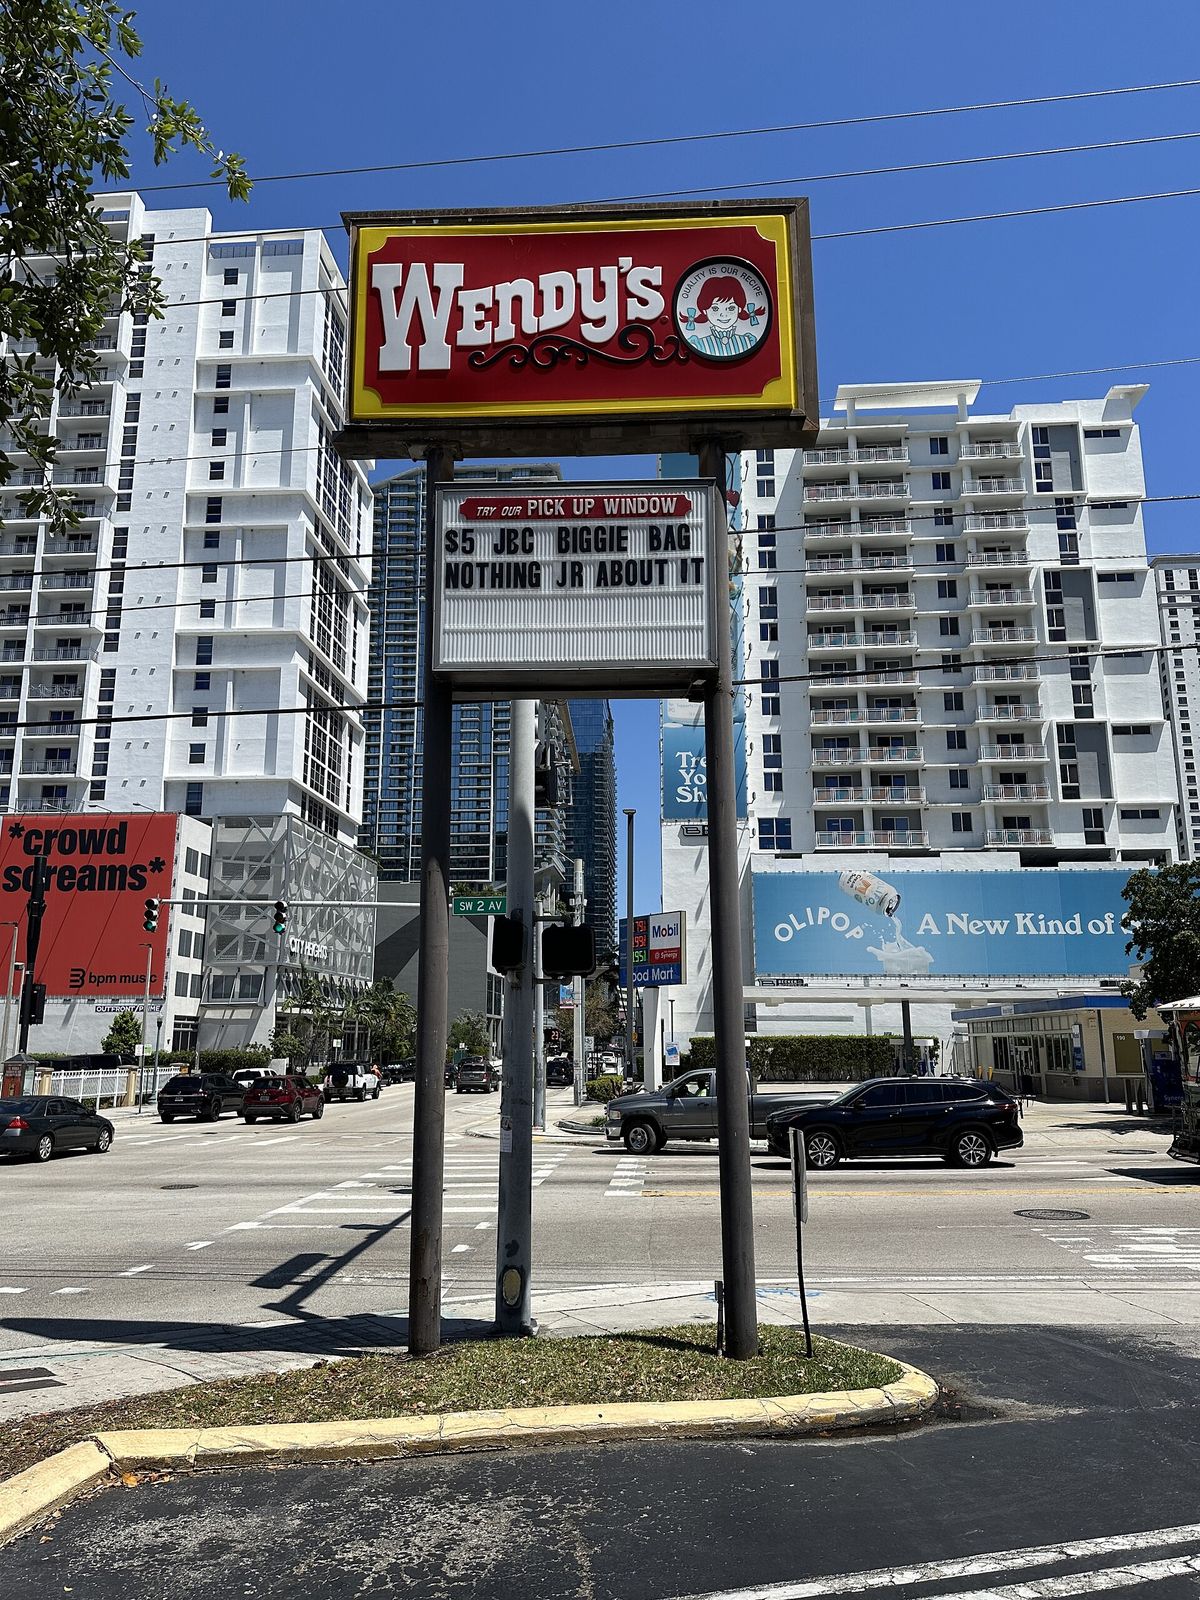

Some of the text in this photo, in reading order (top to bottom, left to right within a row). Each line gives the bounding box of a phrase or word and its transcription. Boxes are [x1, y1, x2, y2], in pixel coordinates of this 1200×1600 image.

[681, 266, 763, 299] QUALITY IS OUR RECIPE
[476, 497, 678, 516] TRY OUR PICK UP WINDOW
[494, 527, 534, 555] JBC
[558, 525, 628, 554] BIGGIE
[650, 523, 690, 551] BAG
[445, 557, 704, 589] NOTHING JR ABOUT IT
[675, 751, 706, 768] Tre
[678, 769, 707, 785] Yo
[675, 786, 707, 803] Sh
[459, 900, 502, 911] SW 2 AV
[652, 923, 679, 939] Mobil
[774, 906, 864, 942] OLIPOP
[916, 913, 941, 935] A
[945, 912, 1010, 935] New
[1014, 912, 1083, 935] Kind
[1087, 912, 1115, 935] of
[290, 937, 305, 955] CITY
[89, 972, 157, 987] bpm musc
[632, 967, 674, 981] ood Mart
[551, 1030, 559, 1040] 23
